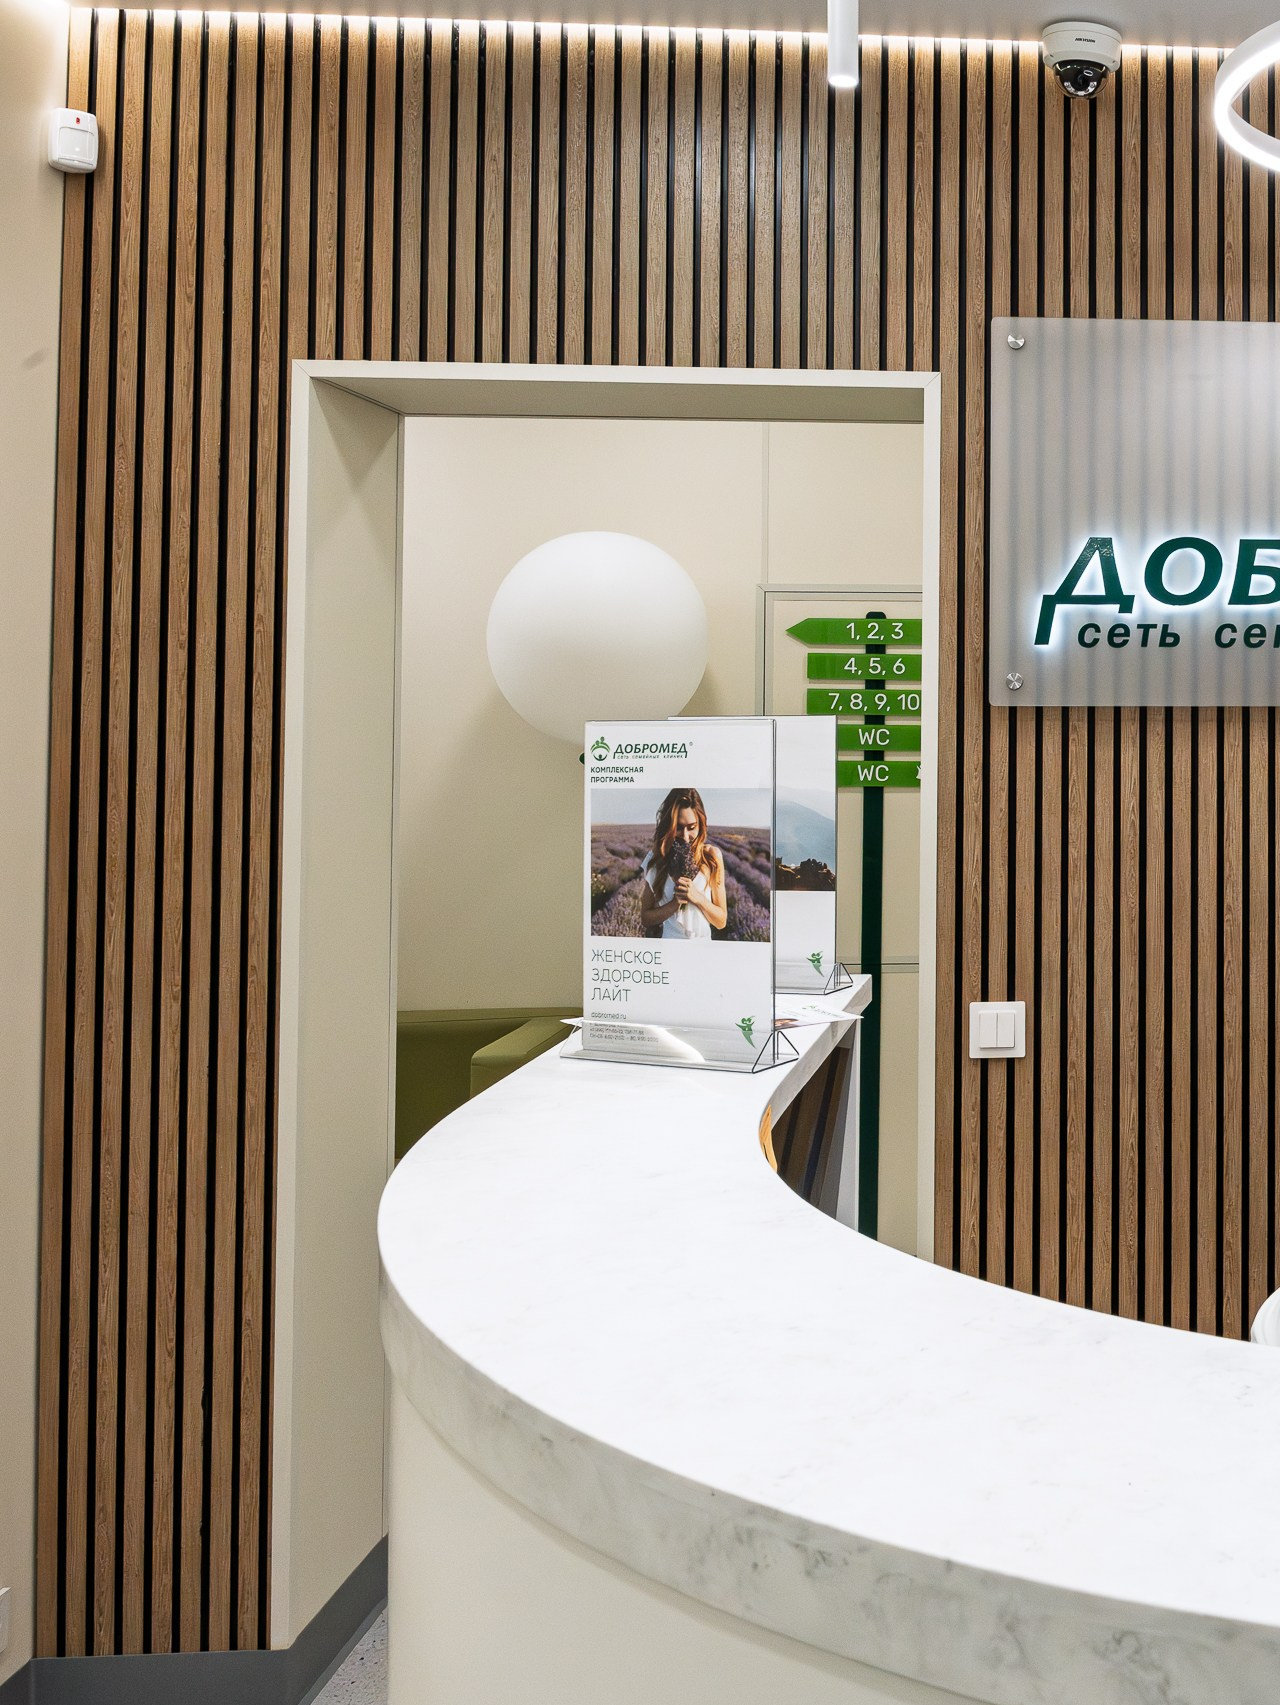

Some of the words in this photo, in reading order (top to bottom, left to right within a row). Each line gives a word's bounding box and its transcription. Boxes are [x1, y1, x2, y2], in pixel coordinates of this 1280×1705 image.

[891, 622, 904, 640] 3
[1077, 621, 1181, 649] сеть
[893, 658, 906, 675] 6
[897, 694, 920, 711] 10
[858, 728, 890, 746] WC
[613, 742, 688, 759] ДОБРОМЕД
[590, 766, 644, 774] КОМПЛЕКСНАЯ
[857, 764, 889, 782] WC
[591, 949, 662, 965] ЖЕНСКОЕ
[591, 968, 670, 985] ЗДОРОВЬЕ
[591, 985, 631, 1002] ЛАЙТ
